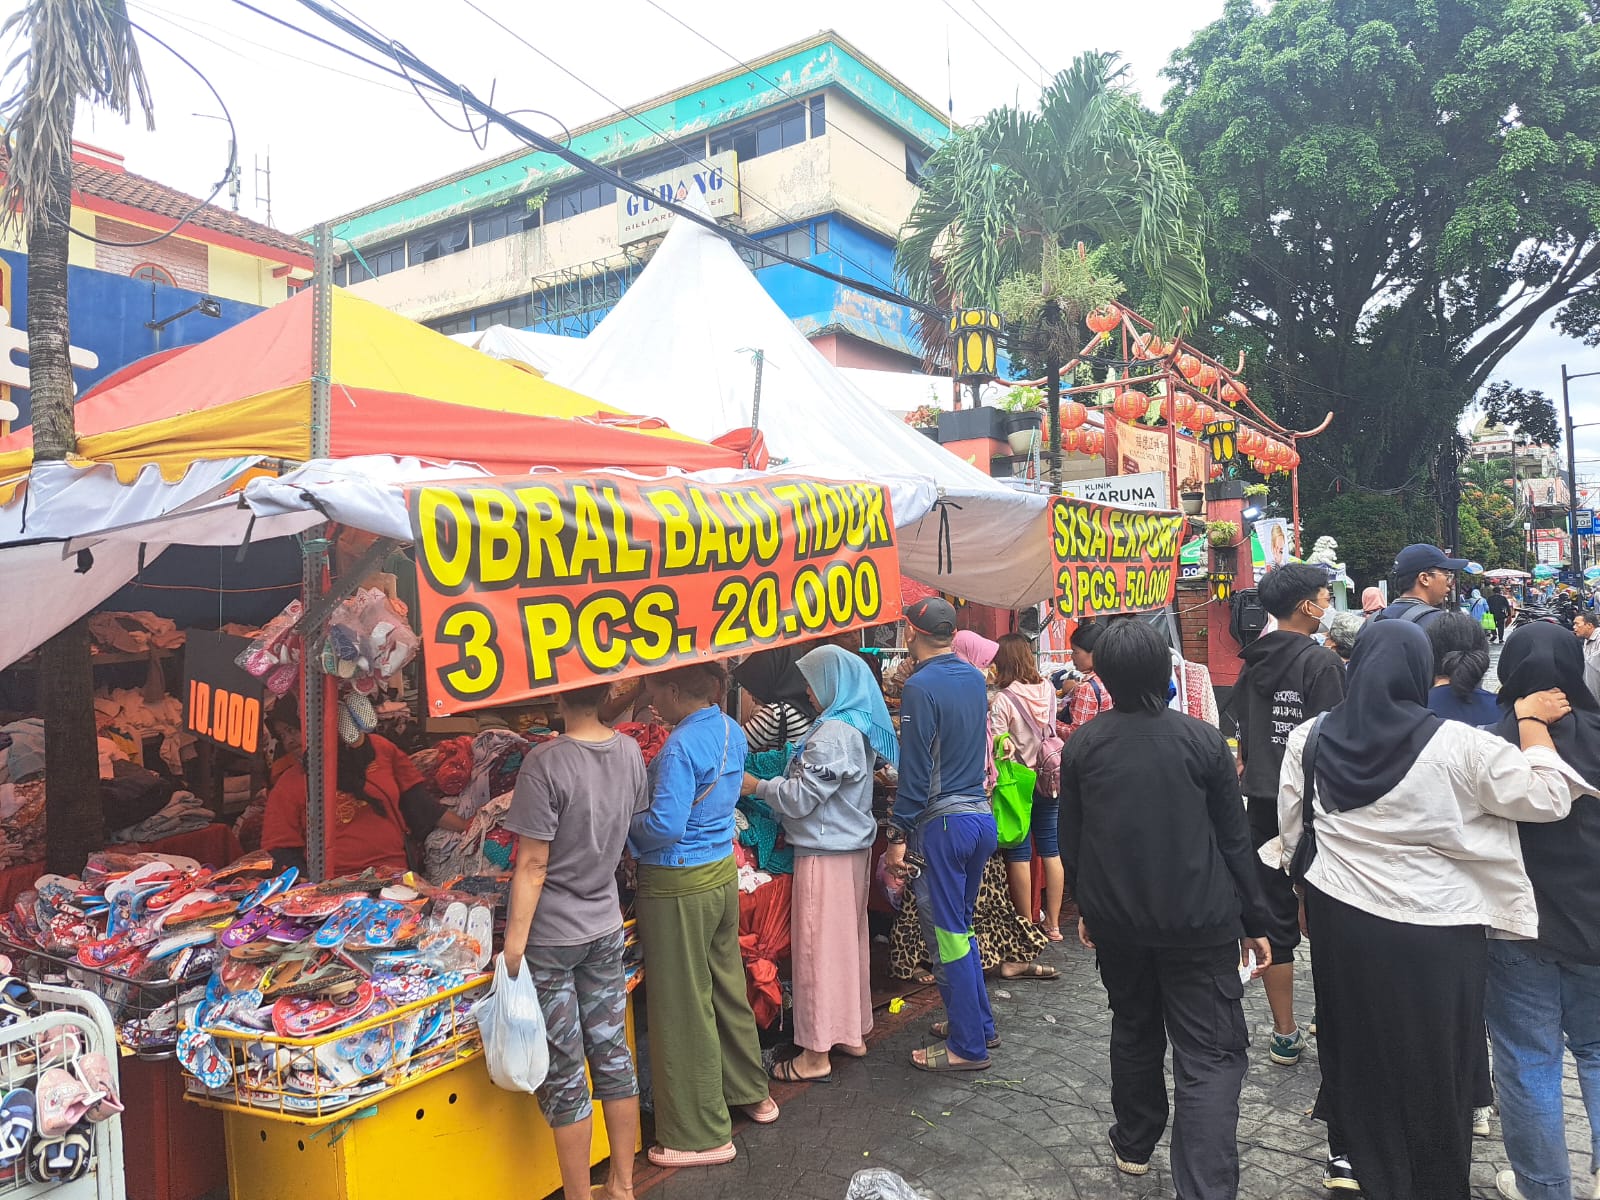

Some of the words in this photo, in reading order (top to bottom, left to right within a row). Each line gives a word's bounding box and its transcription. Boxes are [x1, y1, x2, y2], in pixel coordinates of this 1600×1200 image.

[1084, 482, 1112, 491] KLINIK
[1085, 486, 1156, 503] KARUNA
[417, 483, 648, 589] OBRAL
[644, 486, 781, 570] BAJU
[770, 481, 890, 556] TIDUR
[1053, 502, 1107, 558] SISA
[1108, 510, 1184, 559] EXPORT
[1057, 570, 1074, 614] 3
[1076, 569, 1121, 611] PCS.
[1124, 568, 1172, 608] 50.000
[442, 609, 499, 695] 3
[522, 590, 694, 682] PCS.
[712, 560, 881, 648] 20.000
[187, 678, 261, 754] 10.000
